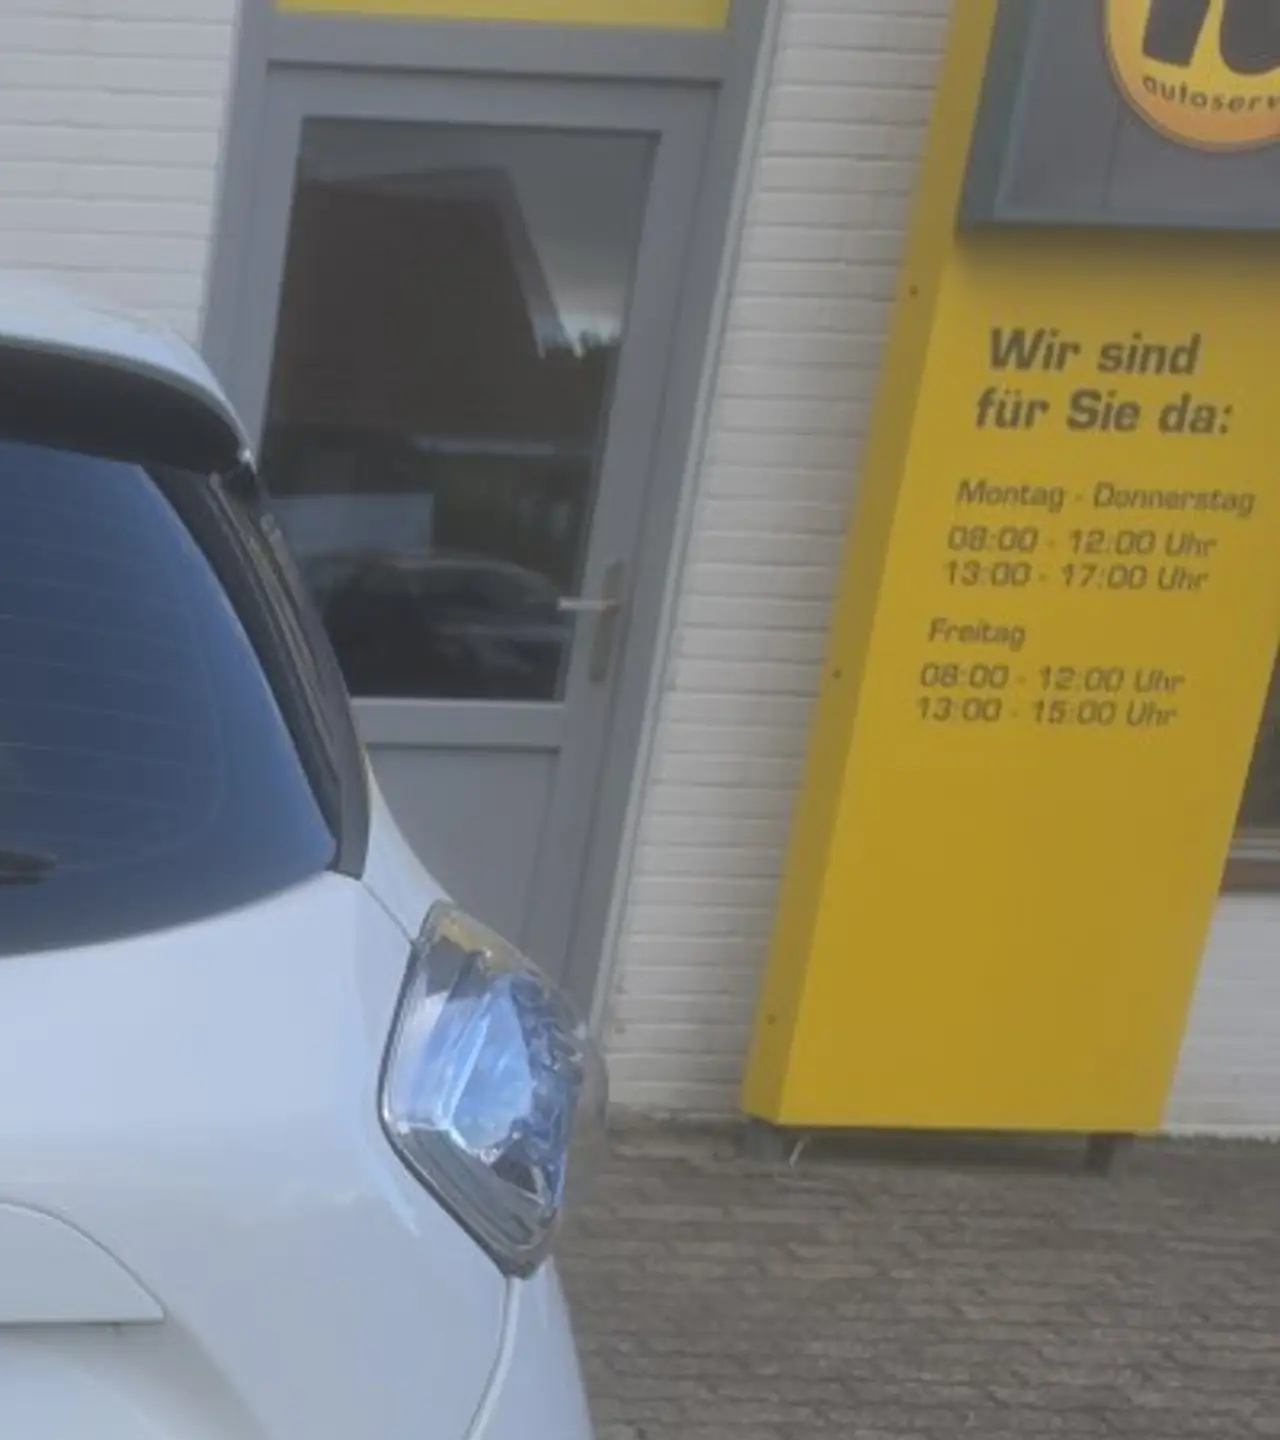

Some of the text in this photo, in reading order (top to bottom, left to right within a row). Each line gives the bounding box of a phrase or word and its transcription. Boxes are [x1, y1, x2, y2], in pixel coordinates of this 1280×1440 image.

[989, 327, 1201, 376] Wir sind
[975, 387, 1233, 435] für Sie da:
[955, 478, 1065, 513] Montag
[1093, 481, 1256, 517] Donnerstag
[947, 525, 1039, 554] 08:00
[1069, 528, 1156, 556] 12:00
[1164, 531, 1218, 558] Uhr
[946, 560, 1033, 587] 13:00
[1061, 563, 1148, 590] 17:00
[1157, 566, 1210, 592] Uhr
[926, 617, 1026, 652] Freitag
[920, 662, 1010, 690] 08:00
[1039, 665, 1125, 693] 12:00
[1133, 668, 1186, 694] Uhr
[918, 696, 1003, 723] 13:00
[1032, 699, 1118, 727] 15:00
[1126, 702, 1179, 728] Uhr
